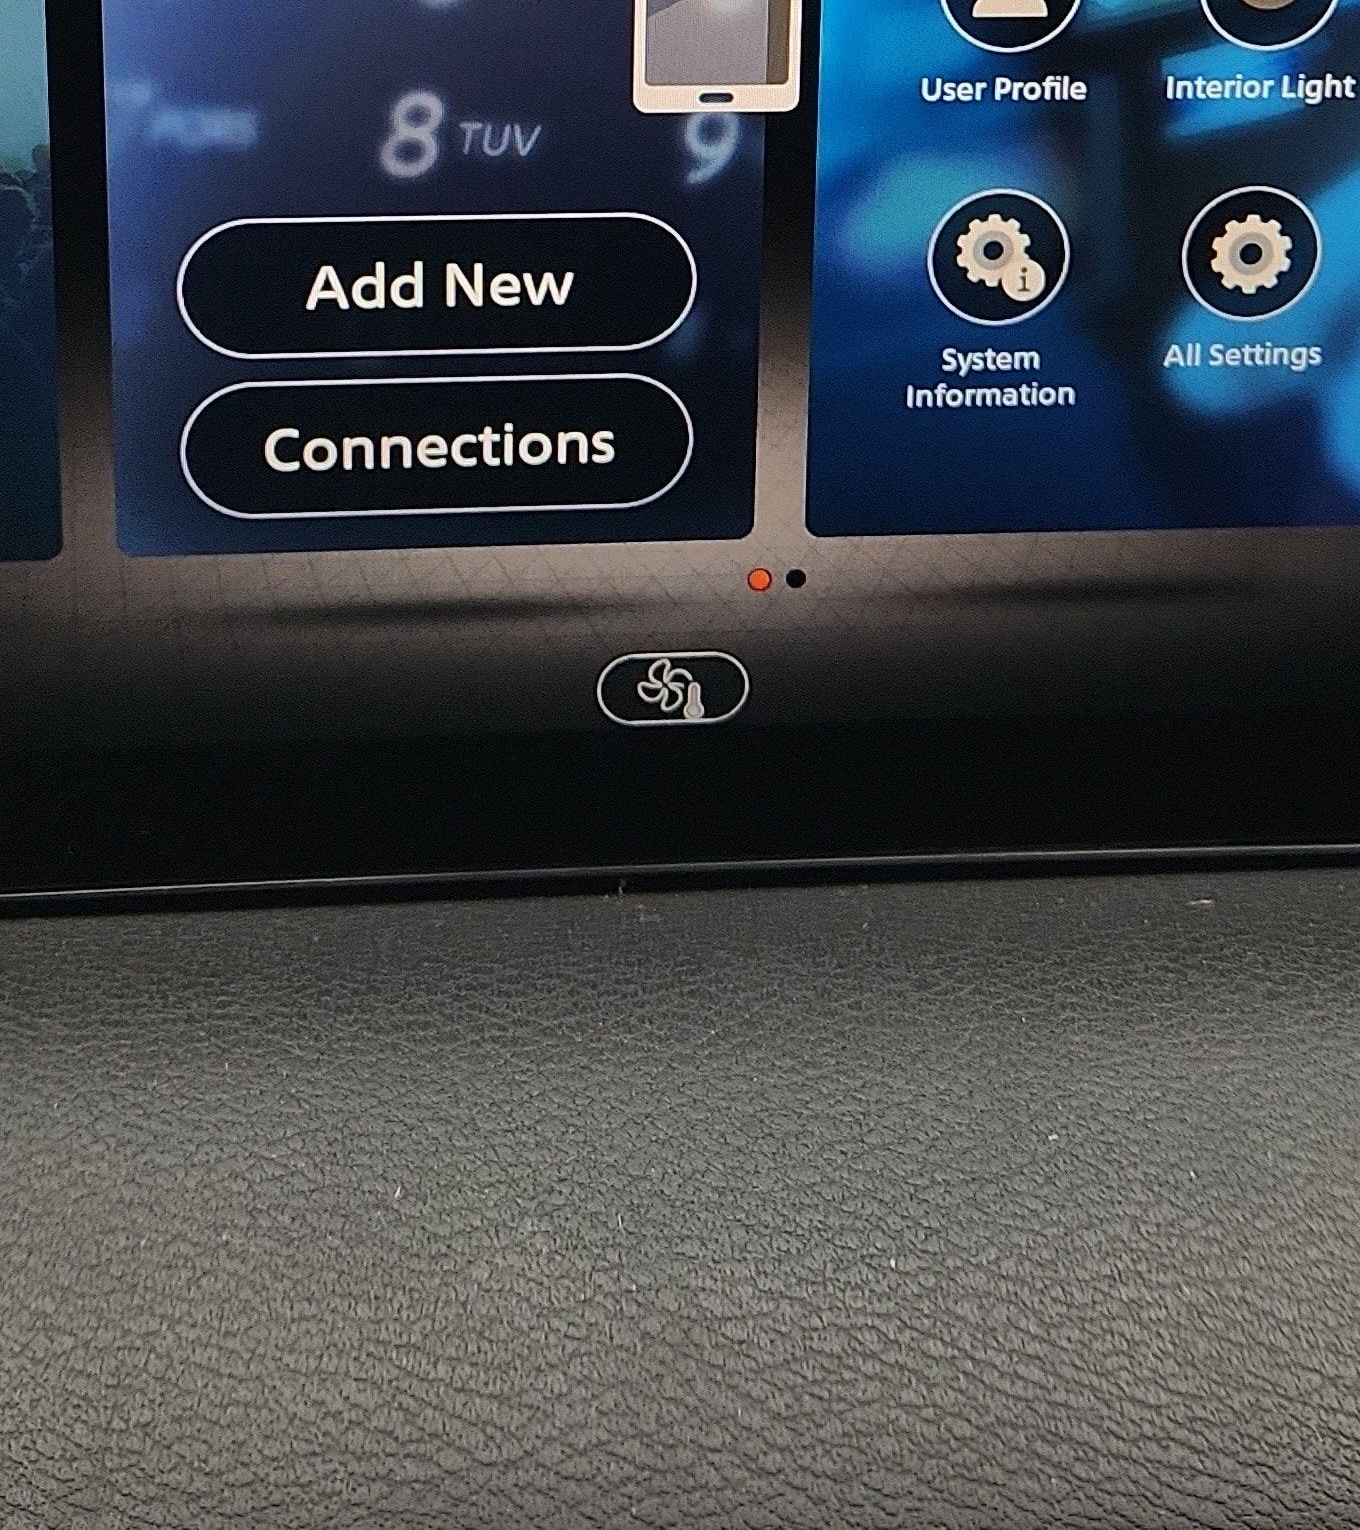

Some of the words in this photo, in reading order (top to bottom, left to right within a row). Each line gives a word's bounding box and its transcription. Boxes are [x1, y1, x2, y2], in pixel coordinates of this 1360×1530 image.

[920, 76, 987, 102] User
[994, 76, 1088, 102] Profile
[1166, 74, 1273, 101] Interior
[1281, 73, 1357, 104] Light
[380, 89, 444, 178] 8
[459, 121, 542, 157] TUV
[684, 112, 738, 185] 9
[305, 261, 424, 311] Add
[445, 262, 575, 308] New
[942, 348, 1041, 375] System
[1163, 343, 1201, 369] All
[1209, 342, 1323, 372] Settings
[905, 383, 1076, 409] Information
[264, 422, 616, 473] Connections
